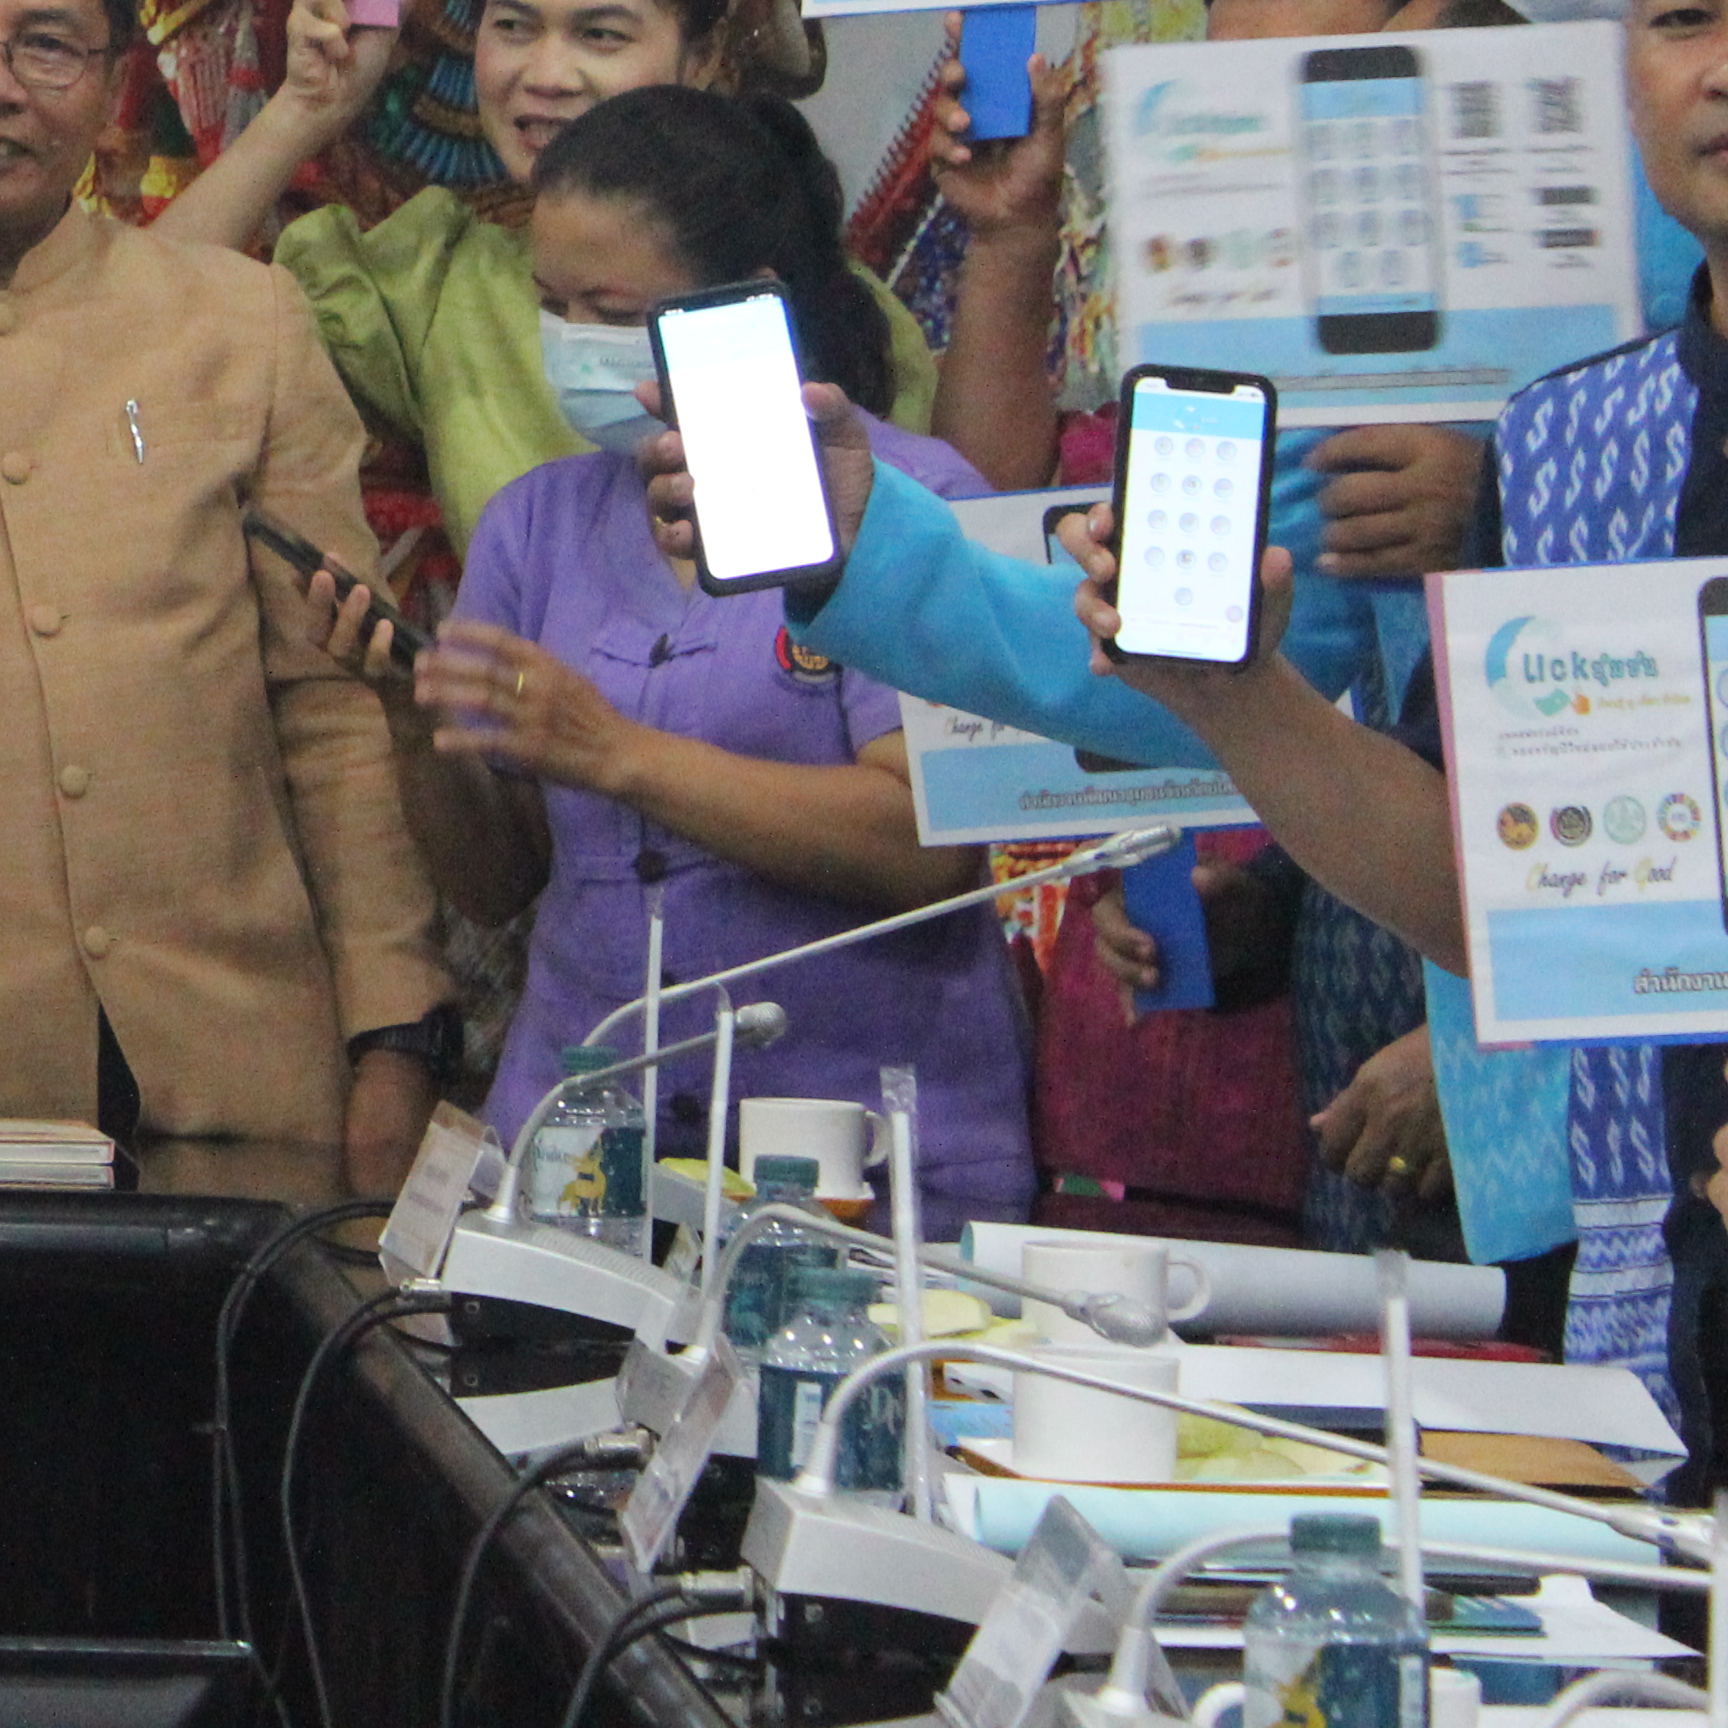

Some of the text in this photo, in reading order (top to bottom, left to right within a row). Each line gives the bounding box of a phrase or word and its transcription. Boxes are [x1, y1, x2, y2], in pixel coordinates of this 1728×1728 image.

[1526, 856, 1677, 898] Change for Good
